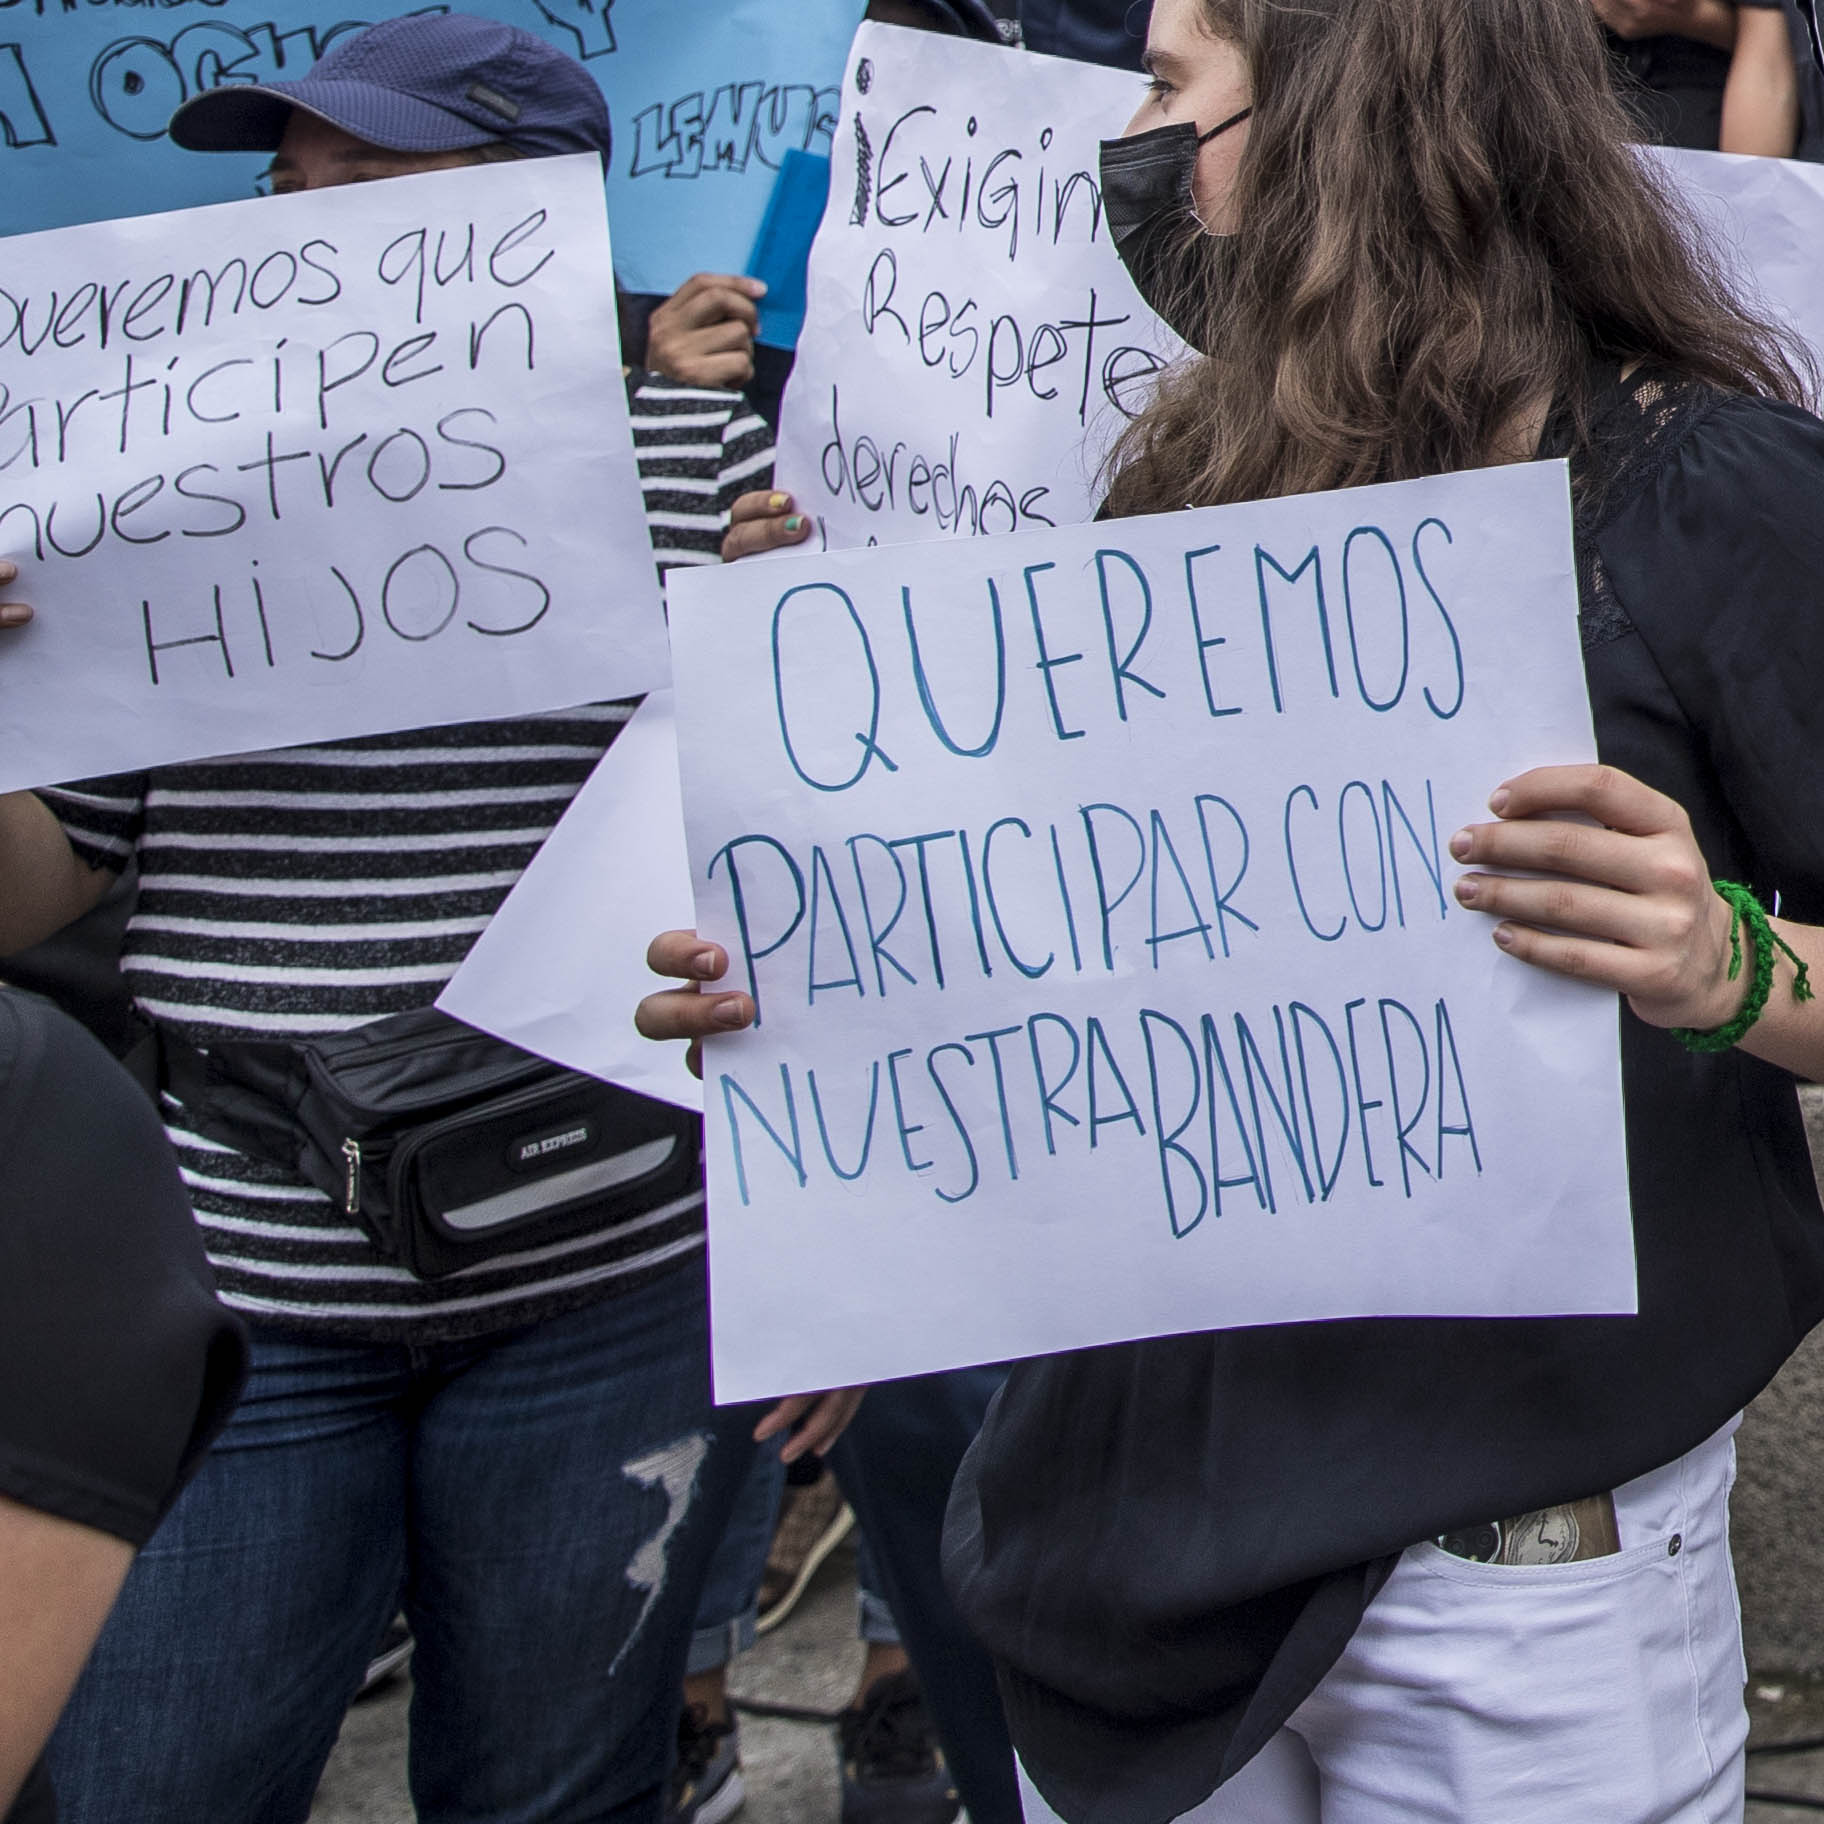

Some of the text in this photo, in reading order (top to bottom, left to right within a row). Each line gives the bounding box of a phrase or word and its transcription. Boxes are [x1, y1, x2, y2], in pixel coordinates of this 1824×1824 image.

[378, 208, 555, 323] que
[0, 303, 535, 469] articipen
[821, 384, 1058, 537] derechos
[771, 517, 1466, 793] QUEREMOS
[706, 779, 1450, 1028] PARTICIPAR CON
[719, 998, 1483, 1240] NUESTRA BANDERA
